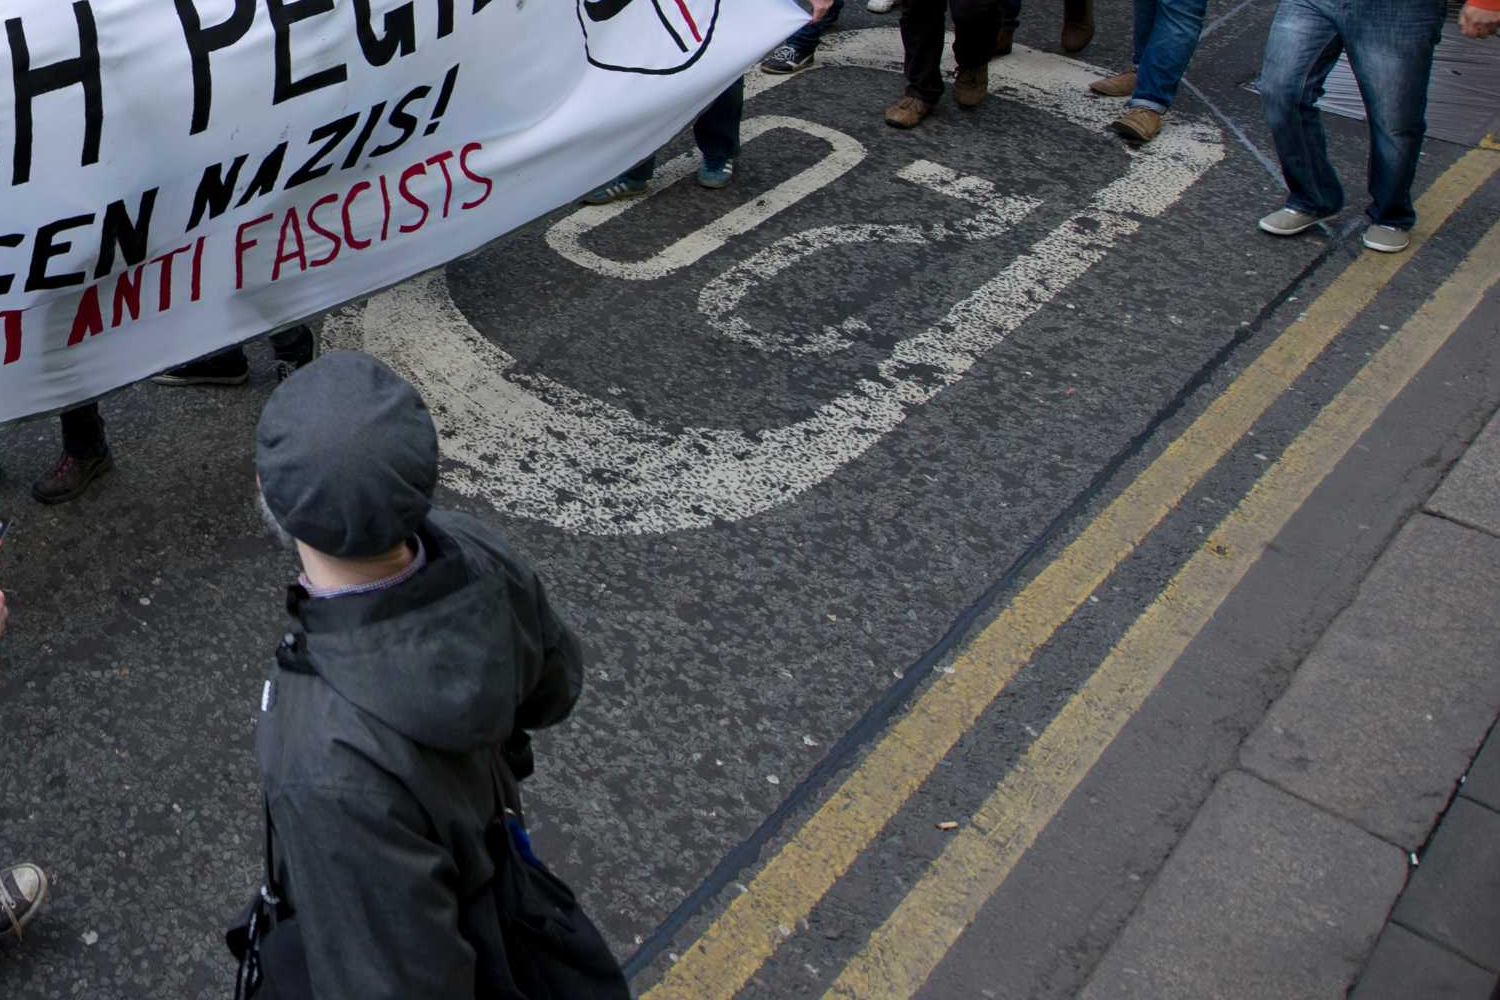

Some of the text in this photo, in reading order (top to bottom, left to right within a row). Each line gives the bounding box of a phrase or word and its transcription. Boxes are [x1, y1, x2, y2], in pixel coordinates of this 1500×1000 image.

[185, 63, 460, 232] NAZIS!
[66, 236, 207, 348] ANTI
[233, 141, 494, 291] FASCISTS
